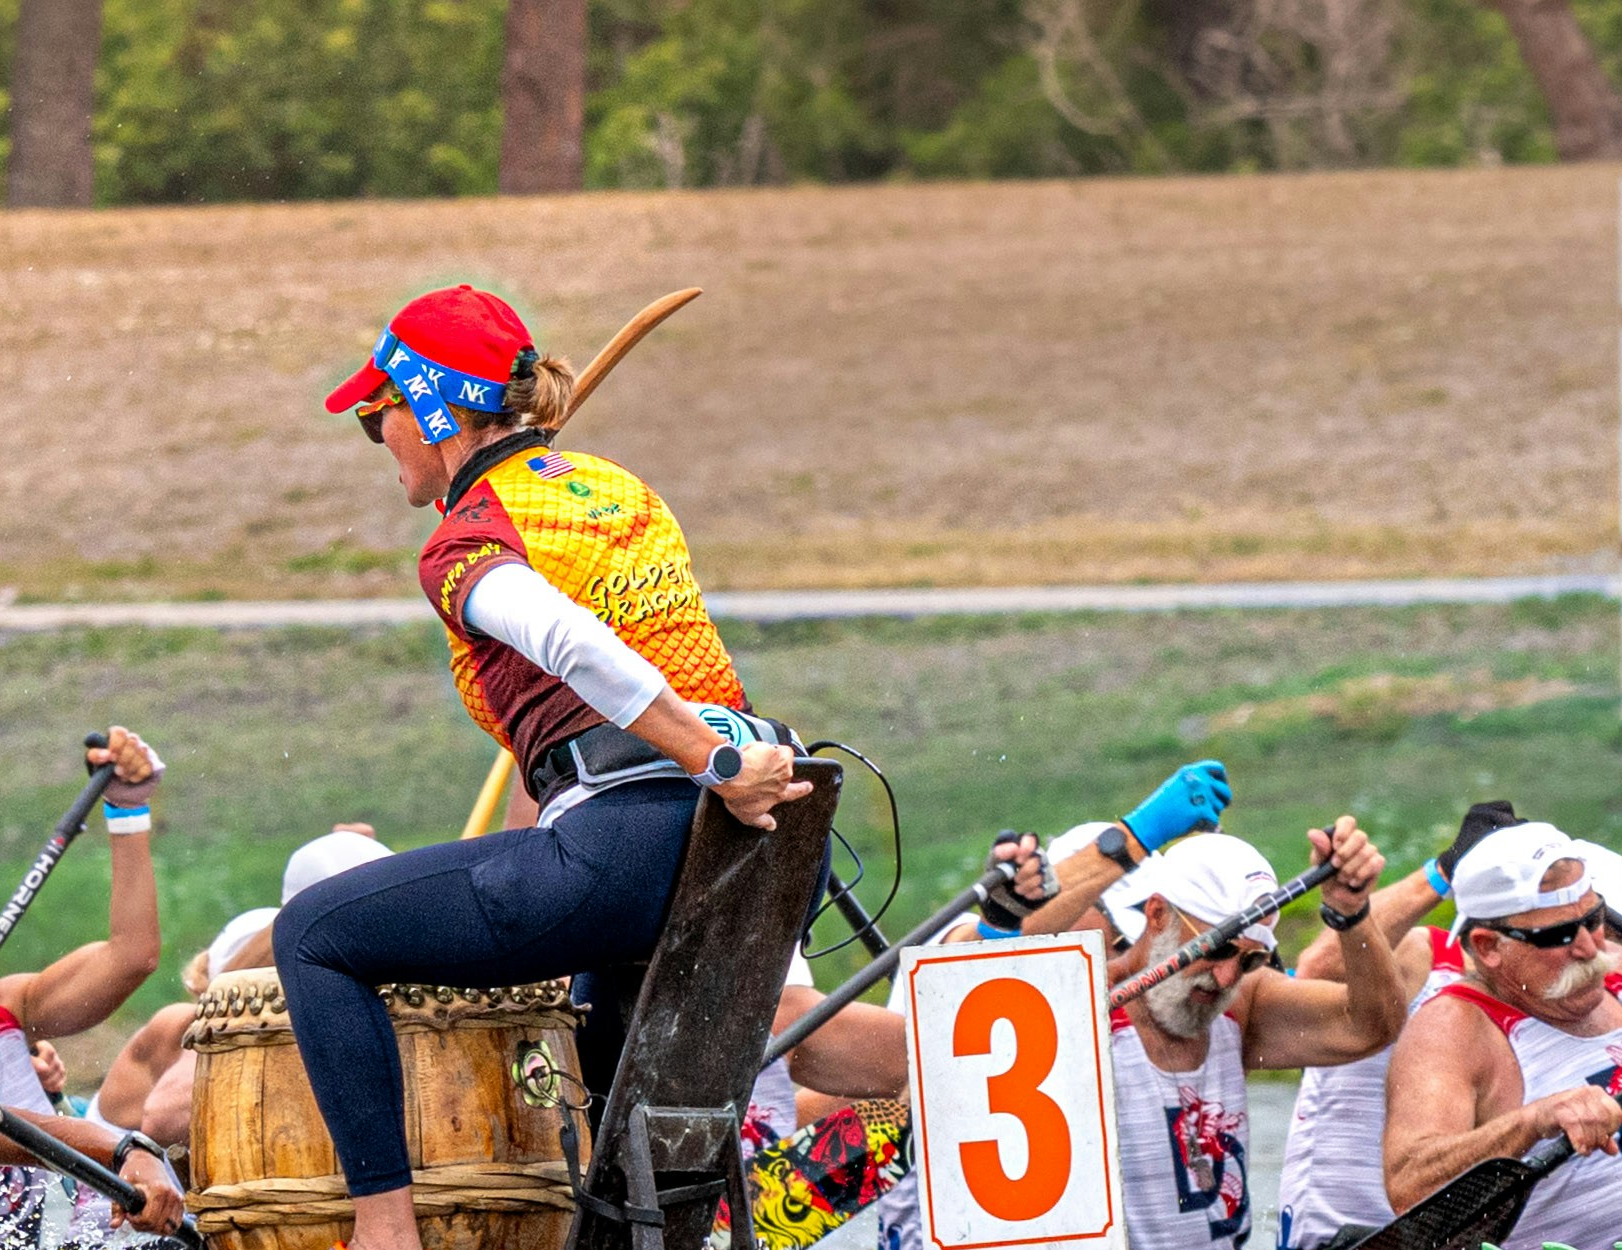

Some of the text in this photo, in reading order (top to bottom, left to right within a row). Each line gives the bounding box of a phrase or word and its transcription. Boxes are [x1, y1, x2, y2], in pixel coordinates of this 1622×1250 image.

[457, 379, 491, 405] NK
[423, 407, 453, 438] NK
[952, 977, 1073, 1222] 3
